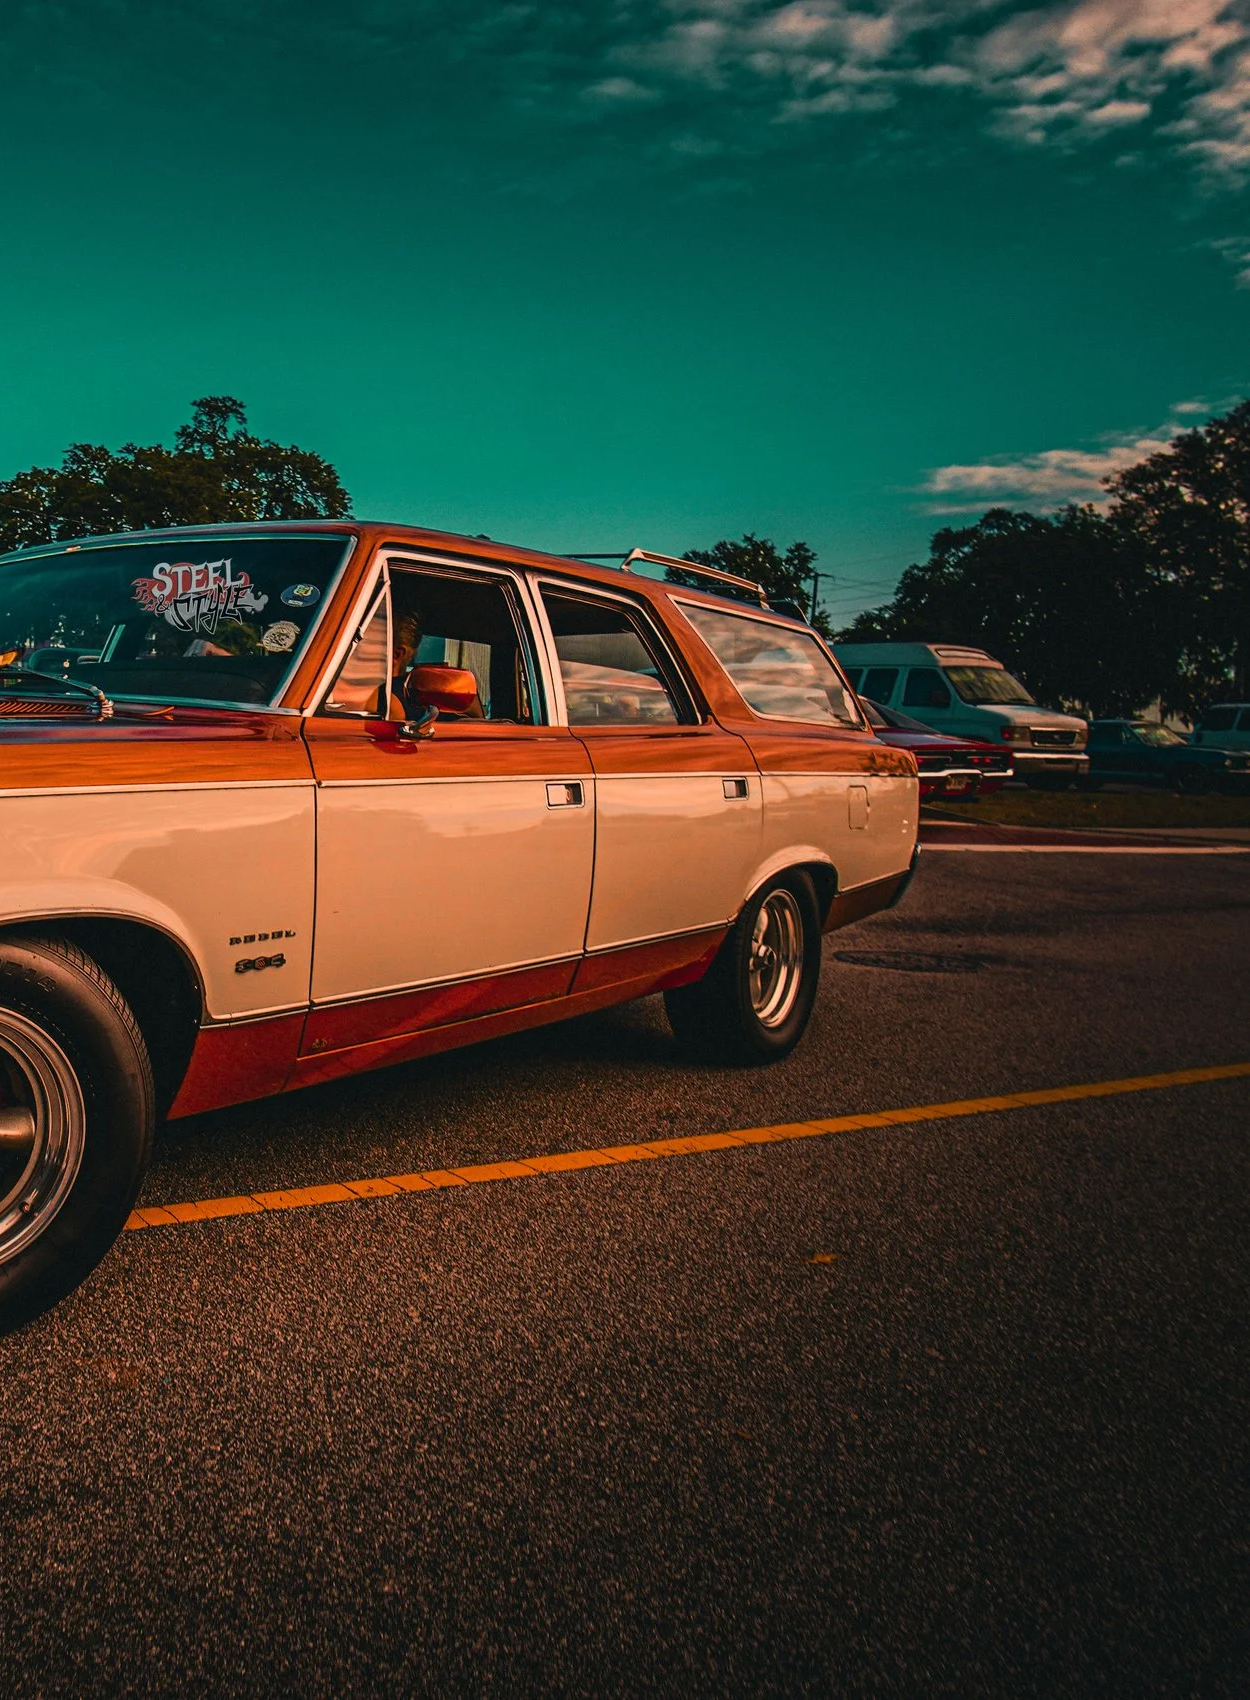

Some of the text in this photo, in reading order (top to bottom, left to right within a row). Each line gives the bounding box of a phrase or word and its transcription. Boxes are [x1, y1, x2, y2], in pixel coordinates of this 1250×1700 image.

[151, 558, 246, 598] STEEL
[155, 594, 170, 612] &
[171, 584, 254, 634] STYLE
[229, 930, 296, 946] REBEL
